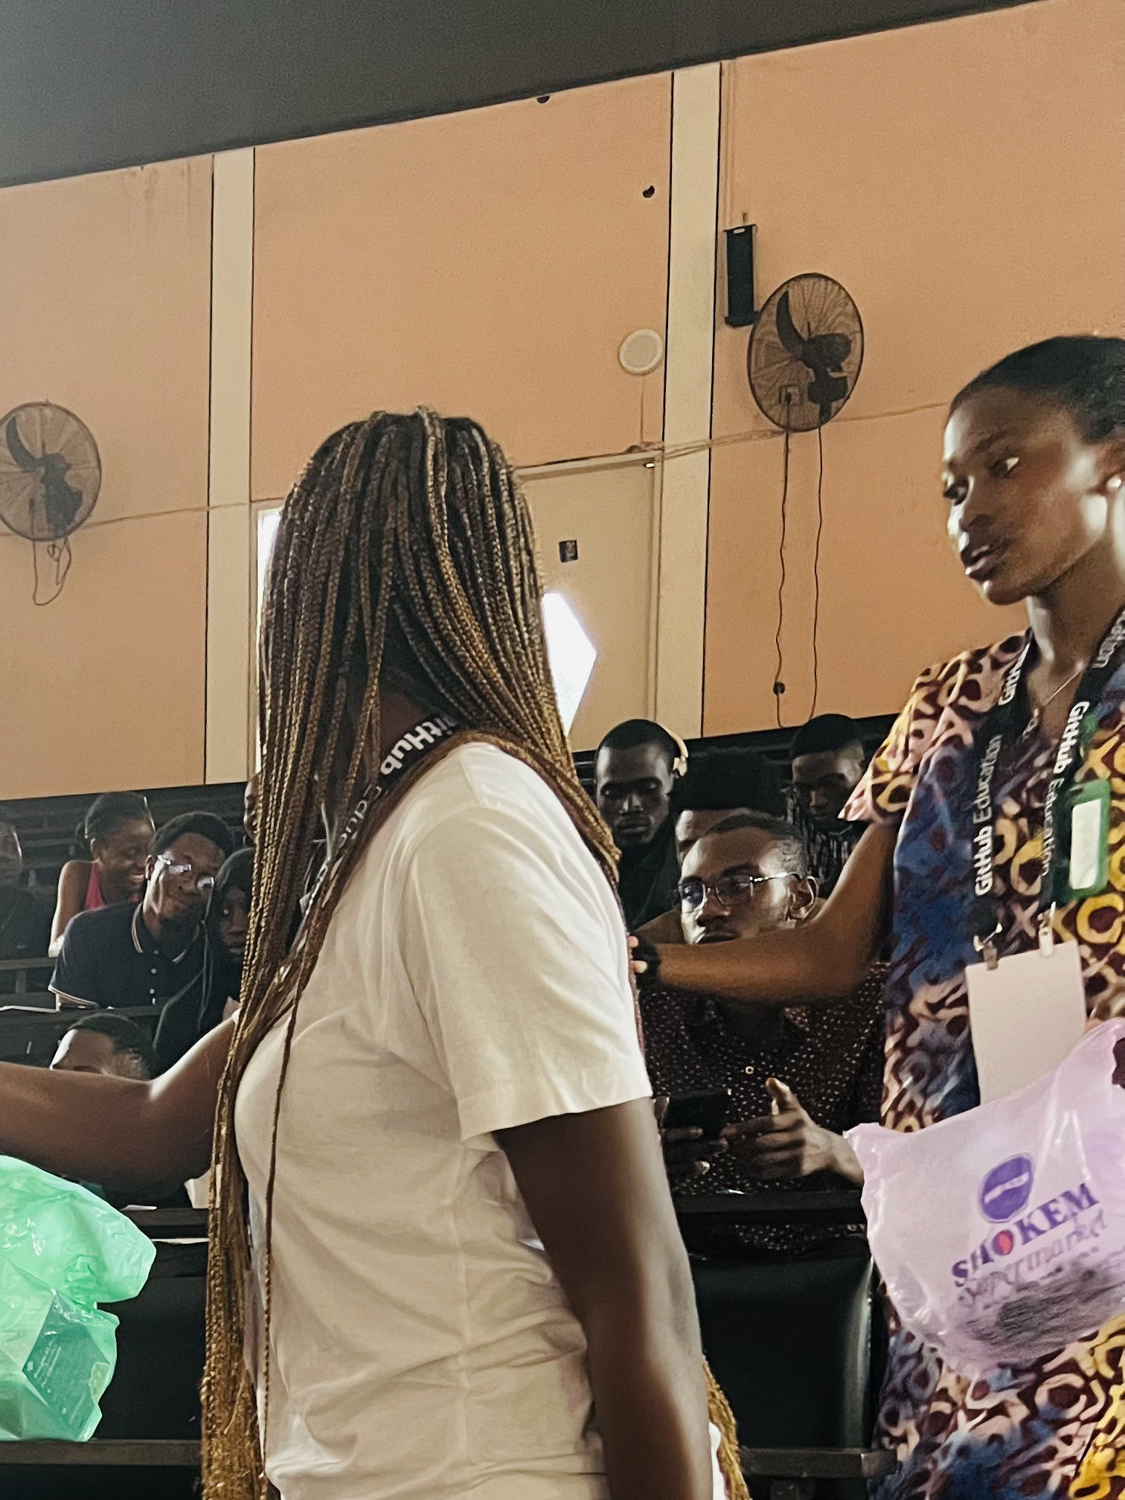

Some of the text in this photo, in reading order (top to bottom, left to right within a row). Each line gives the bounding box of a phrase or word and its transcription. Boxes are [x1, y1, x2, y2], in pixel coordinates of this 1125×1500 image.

[1053, 701, 1090, 774] GitHub
[972, 734, 1003, 896] GitHub Education
[951, 1182, 1100, 1288] SHOKEM
